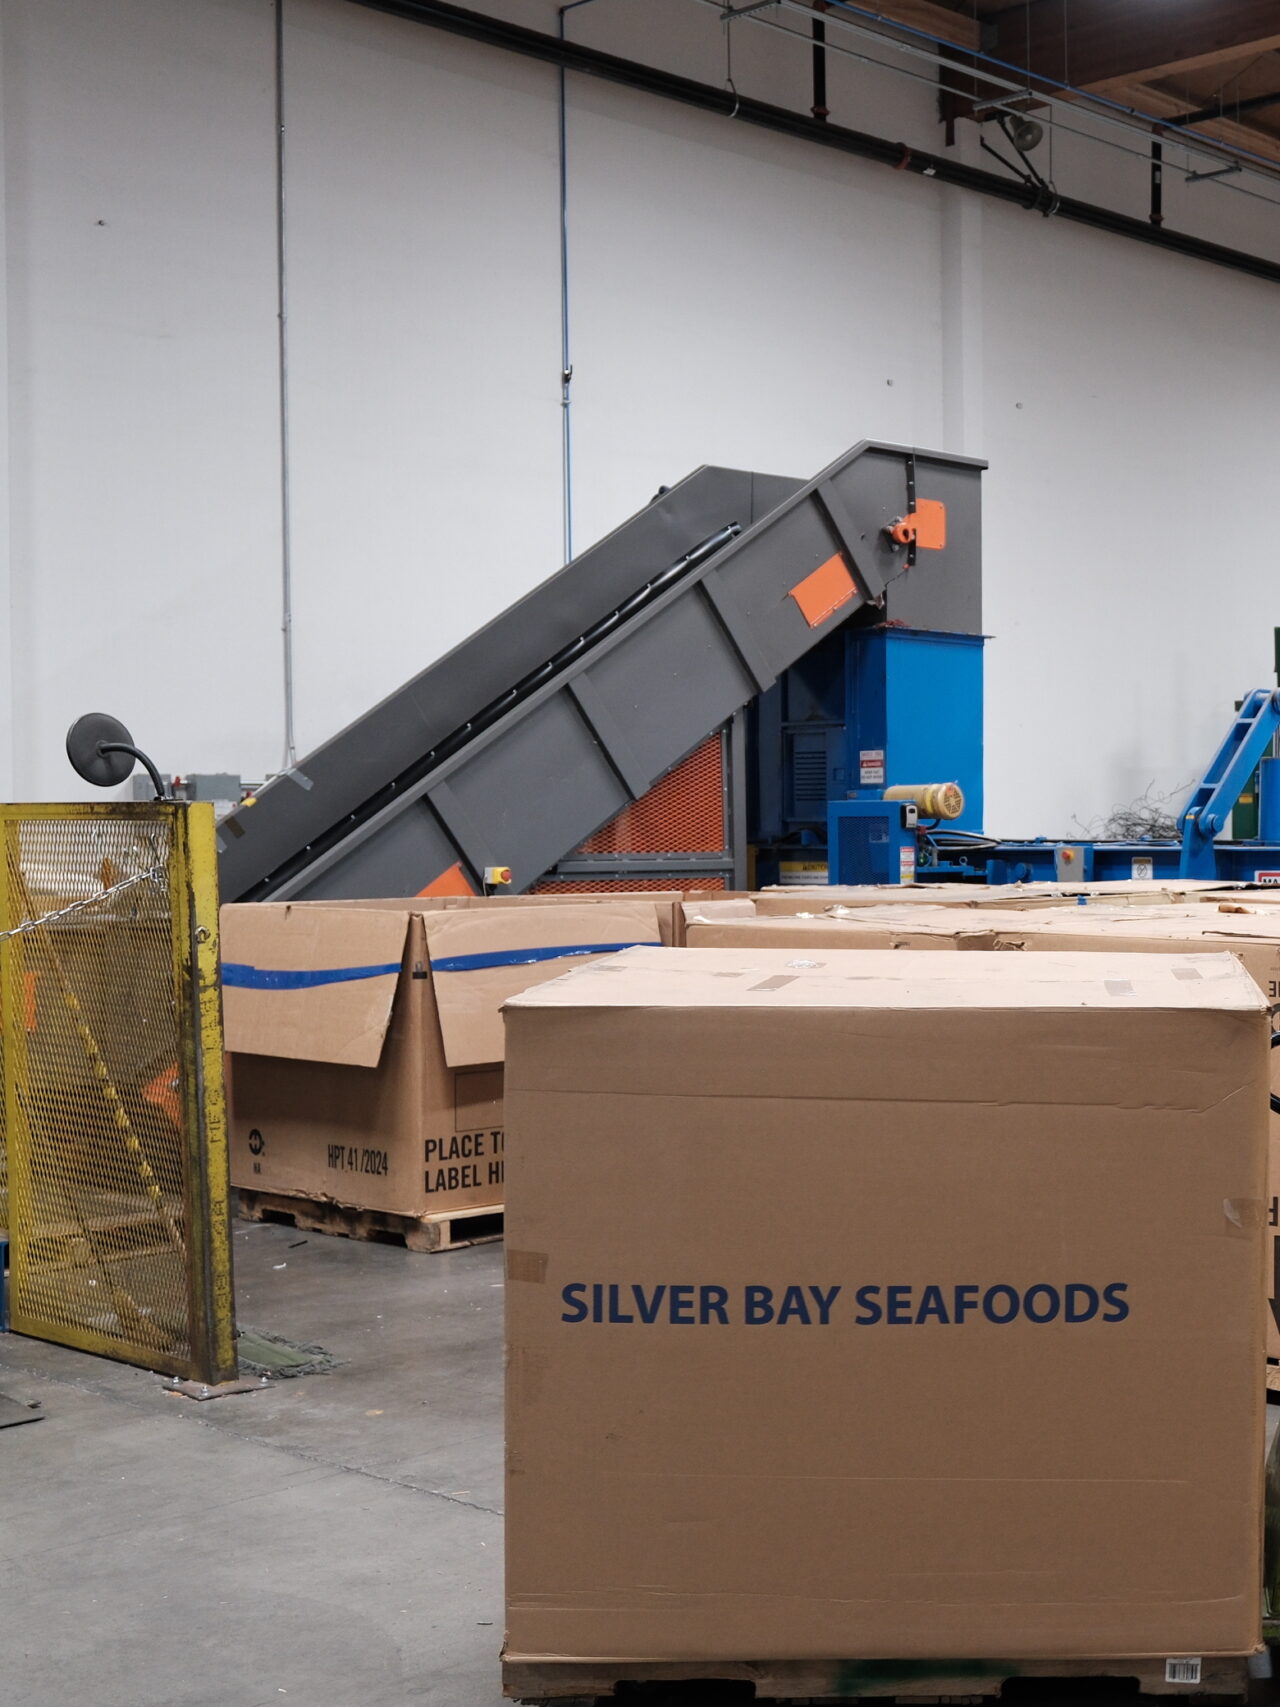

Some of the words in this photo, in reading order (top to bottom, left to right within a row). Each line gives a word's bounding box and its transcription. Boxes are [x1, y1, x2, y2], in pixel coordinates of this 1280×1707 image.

[328, 1144, 345, 1170] HPT
[425, 1133, 484, 1163] PLACE
[425, 1165, 482, 1193] LABEL
[561, 1282, 730, 1325] SILVER
[745, 1285, 842, 1325] BAY
[854, 1282, 1131, 1325] SEAFOODS
